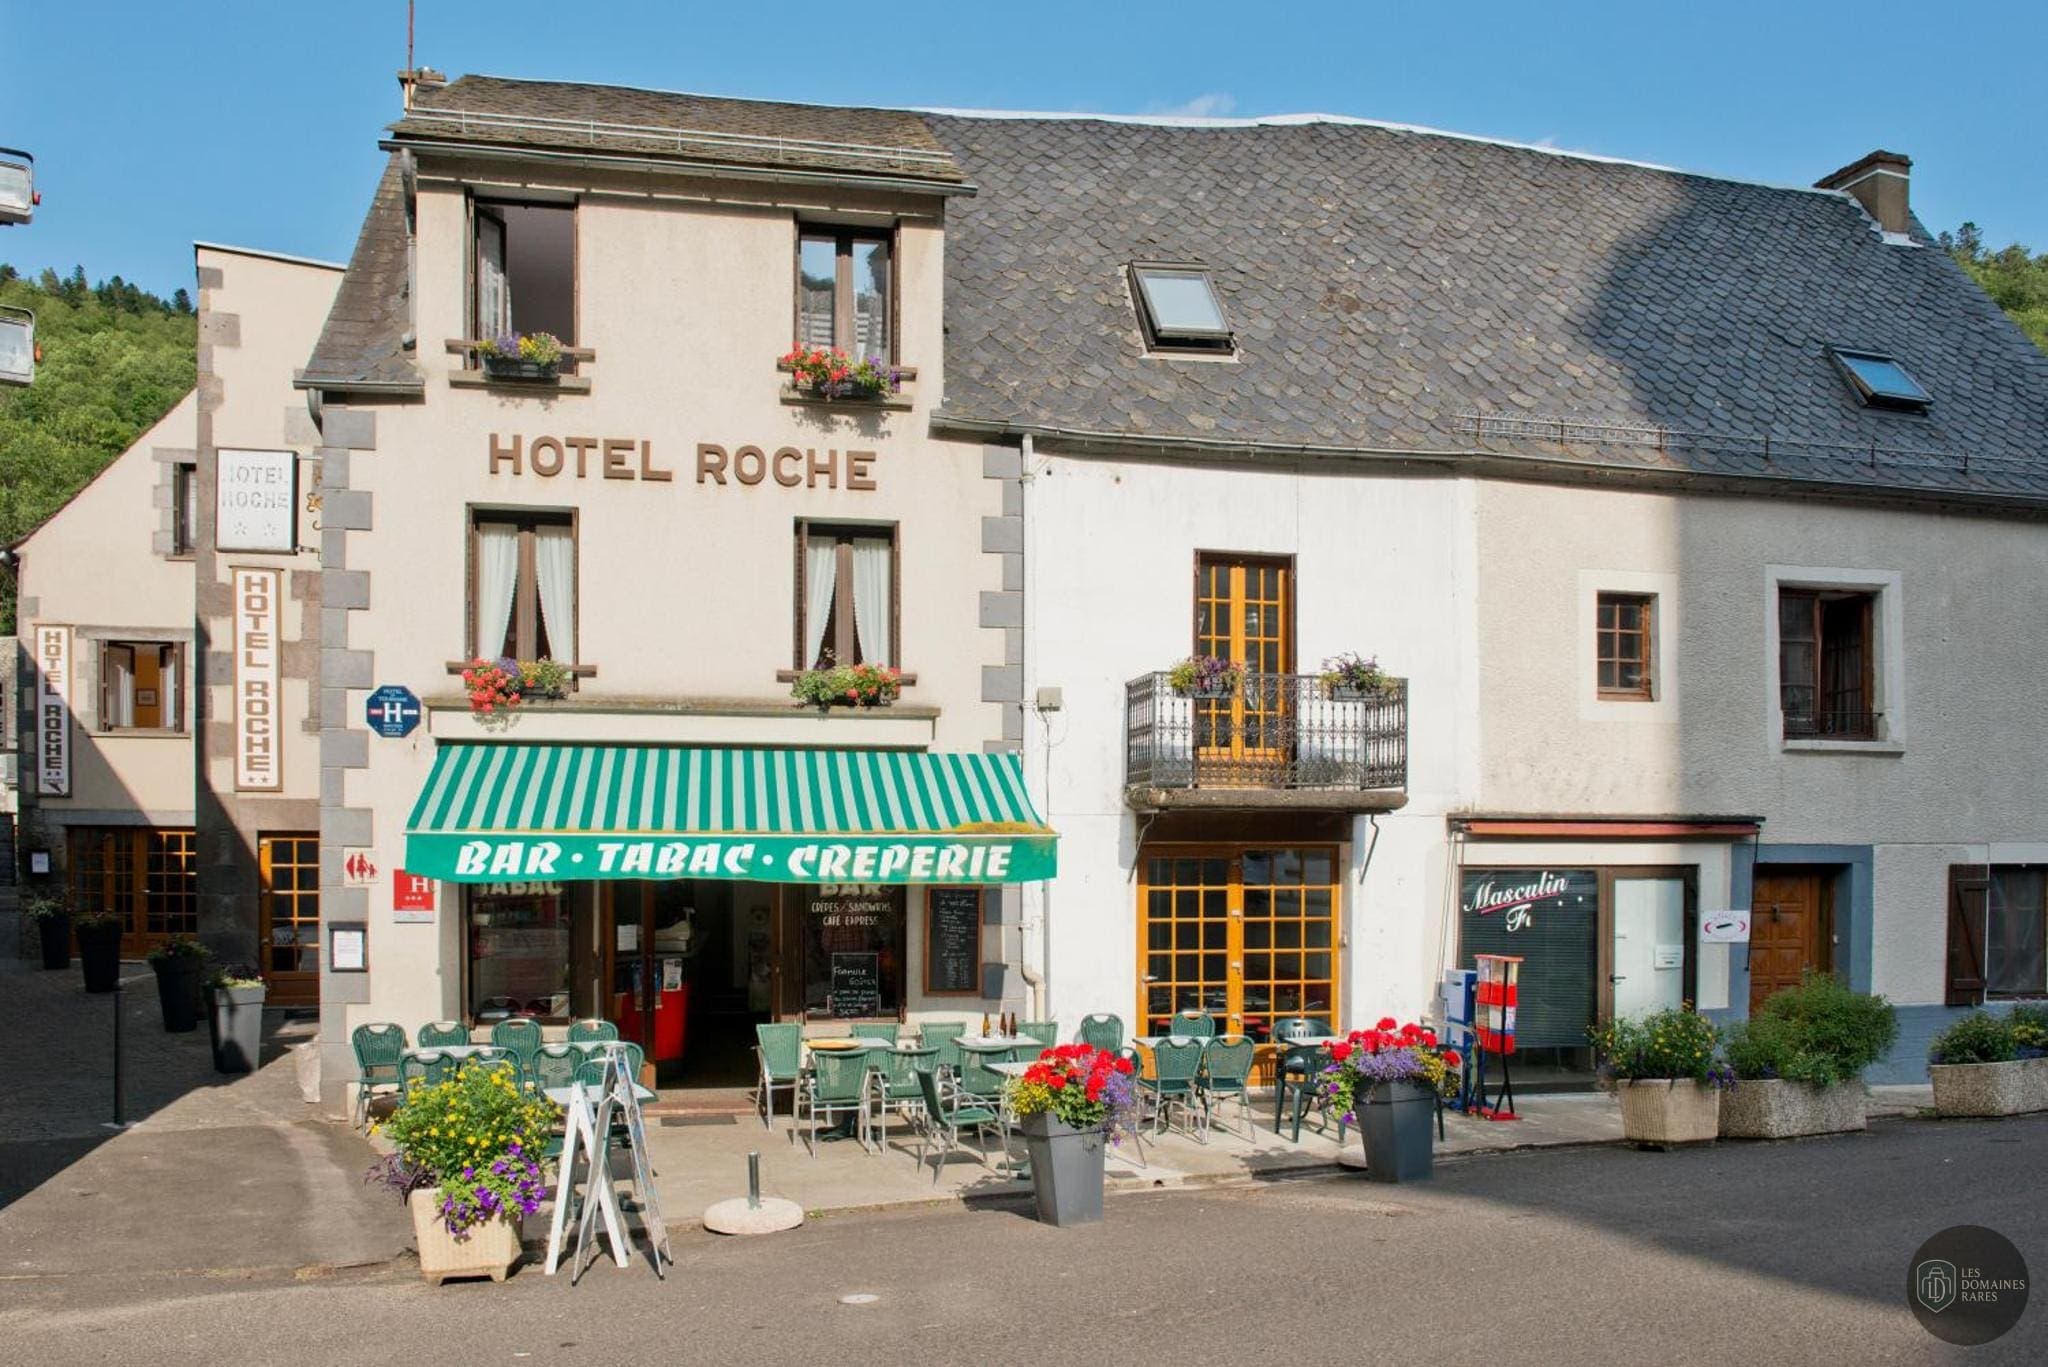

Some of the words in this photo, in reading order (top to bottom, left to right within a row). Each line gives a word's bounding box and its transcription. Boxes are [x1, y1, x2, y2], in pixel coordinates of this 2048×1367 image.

[488, 432, 673, 482] HOTEL
[696, 442, 878, 491] ROCHE
[244, 576, 269, 668] HOTEL
[44, 631, 61, 696] HOTEL
[44, 704, 62, 769] ROCHE
[245, 681, 270, 772] ROCHE
[384, 702, 402, 723] H
[455, 840, 563, 875] BAR
[597, 842, 756, 874] TABAC
[787, 843, 1014, 878] CREPERIE
[1463, 871, 1569, 912] Masculin
